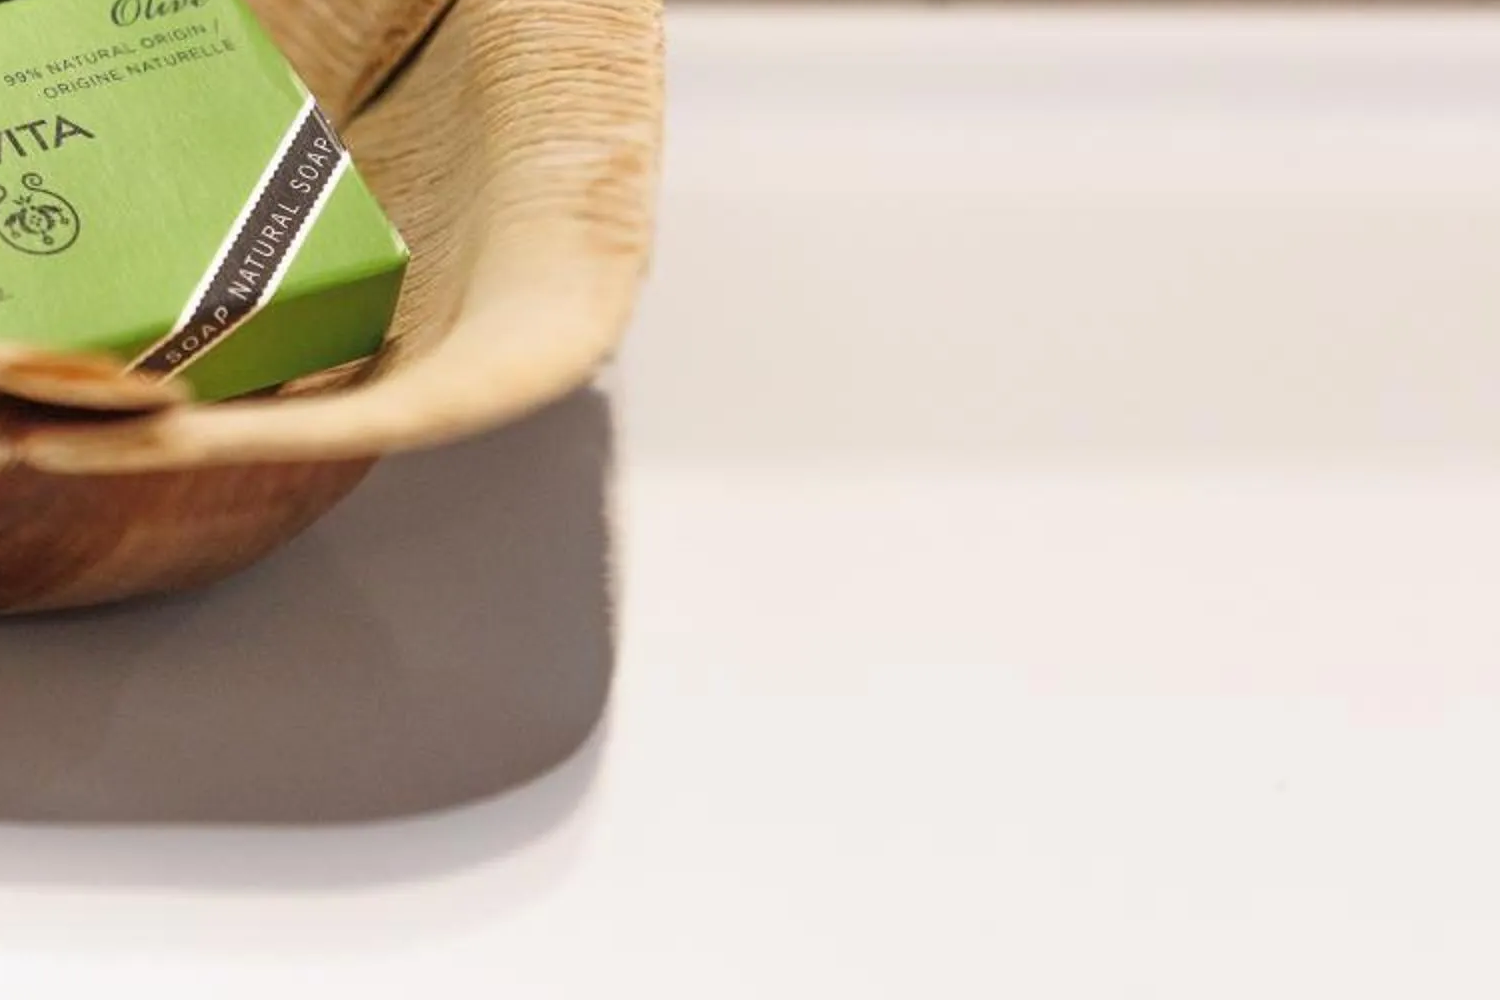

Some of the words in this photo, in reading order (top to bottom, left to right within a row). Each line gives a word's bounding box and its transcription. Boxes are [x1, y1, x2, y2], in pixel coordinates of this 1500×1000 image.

[3, 68, 43, 87] 99%
[45, 41, 137, 75] NATURAL
[140, 23, 207, 50] ORIGIN
[43, 68, 125, 99] ORIGINE
[126, 38, 237, 76] NATURELLE
[165, 304, 230, 366] SOAP
[228, 202, 301, 300] NATURAL
[290, 136, 334, 193] SOAP
